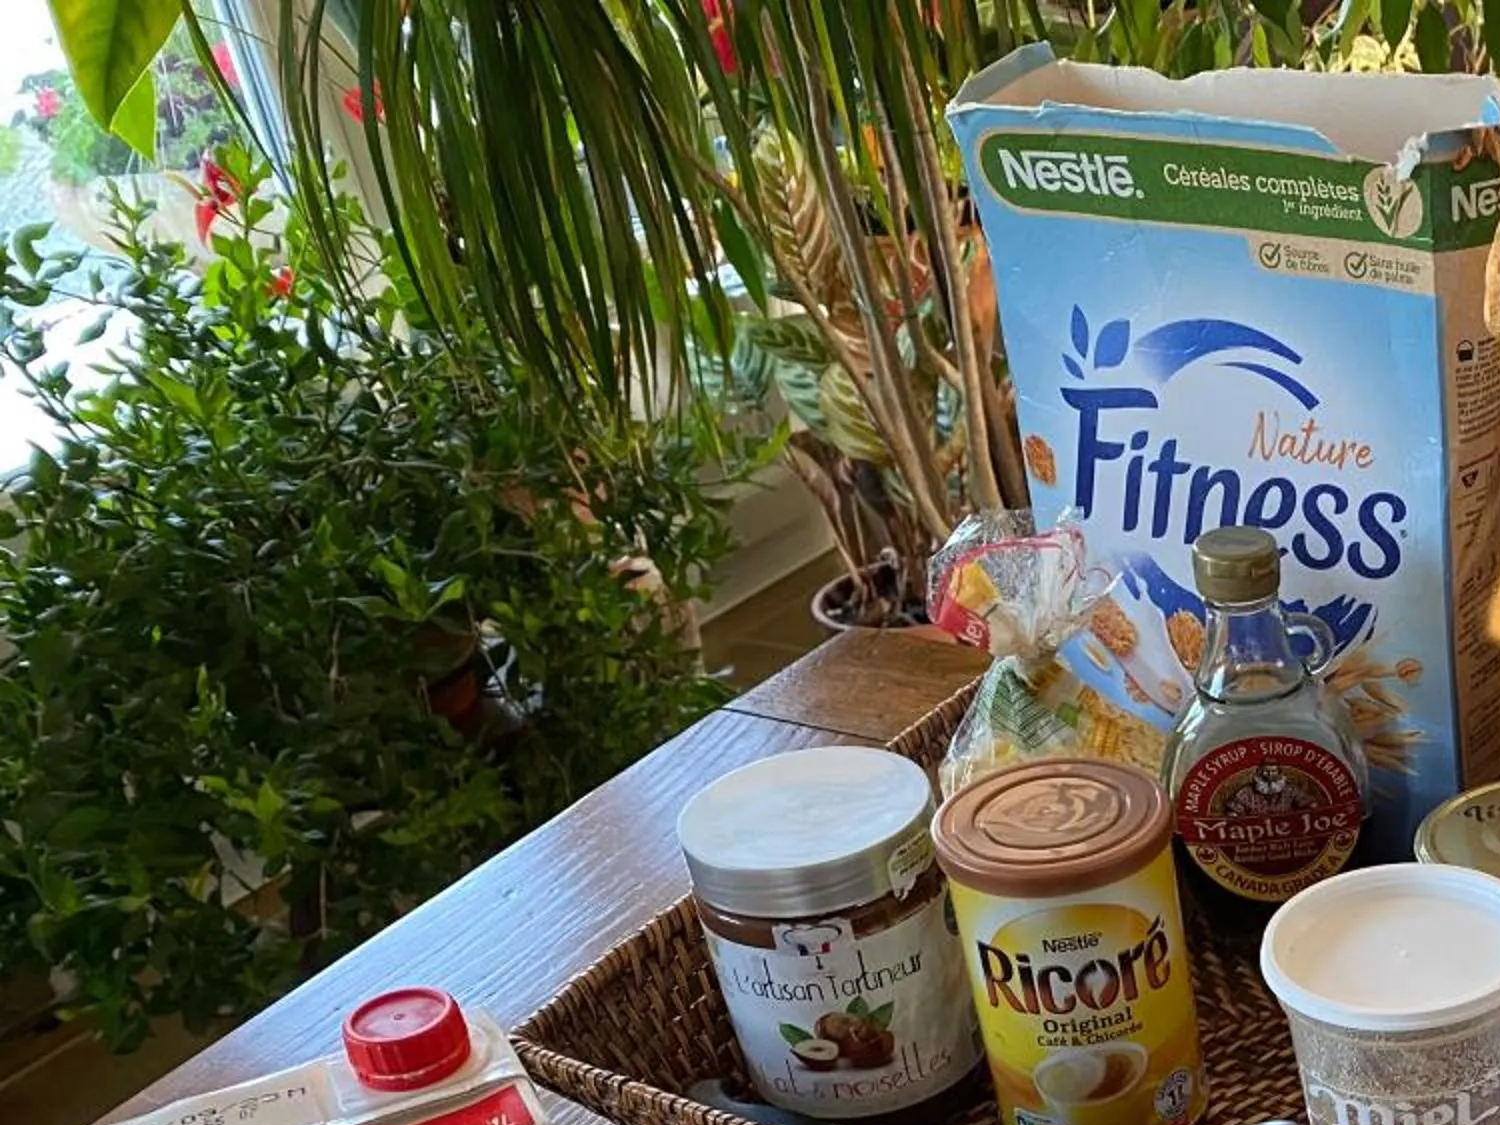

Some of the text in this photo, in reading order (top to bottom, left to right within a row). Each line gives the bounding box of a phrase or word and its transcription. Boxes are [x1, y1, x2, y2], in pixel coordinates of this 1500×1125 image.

[998, 148, 1145, 200] Nestlé
[1163, 163, 1361, 202] Céréales complètes
[1299, 200, 1364, 221] ingrédient
[1248, 410, 1375, 470] Nature
[1060, 387, 1408, 579] Fitness
[1184, 770, 1211, 813] MAPLE
[1205, 747, 1247, 775] SYRUP
[1259, 741, 1303, 757] SIROP
[1194, 812, 1348, 844] Maple Joe
[1216, 864, 1280, 897] CANADA
[976, 914, 1172, 1015] Ricoré
[1042, 931, 1103, 954] Nestlé
[825, 949, 922, 1001] Tartineur
[1043, 1006, 1133, 1036] Original
